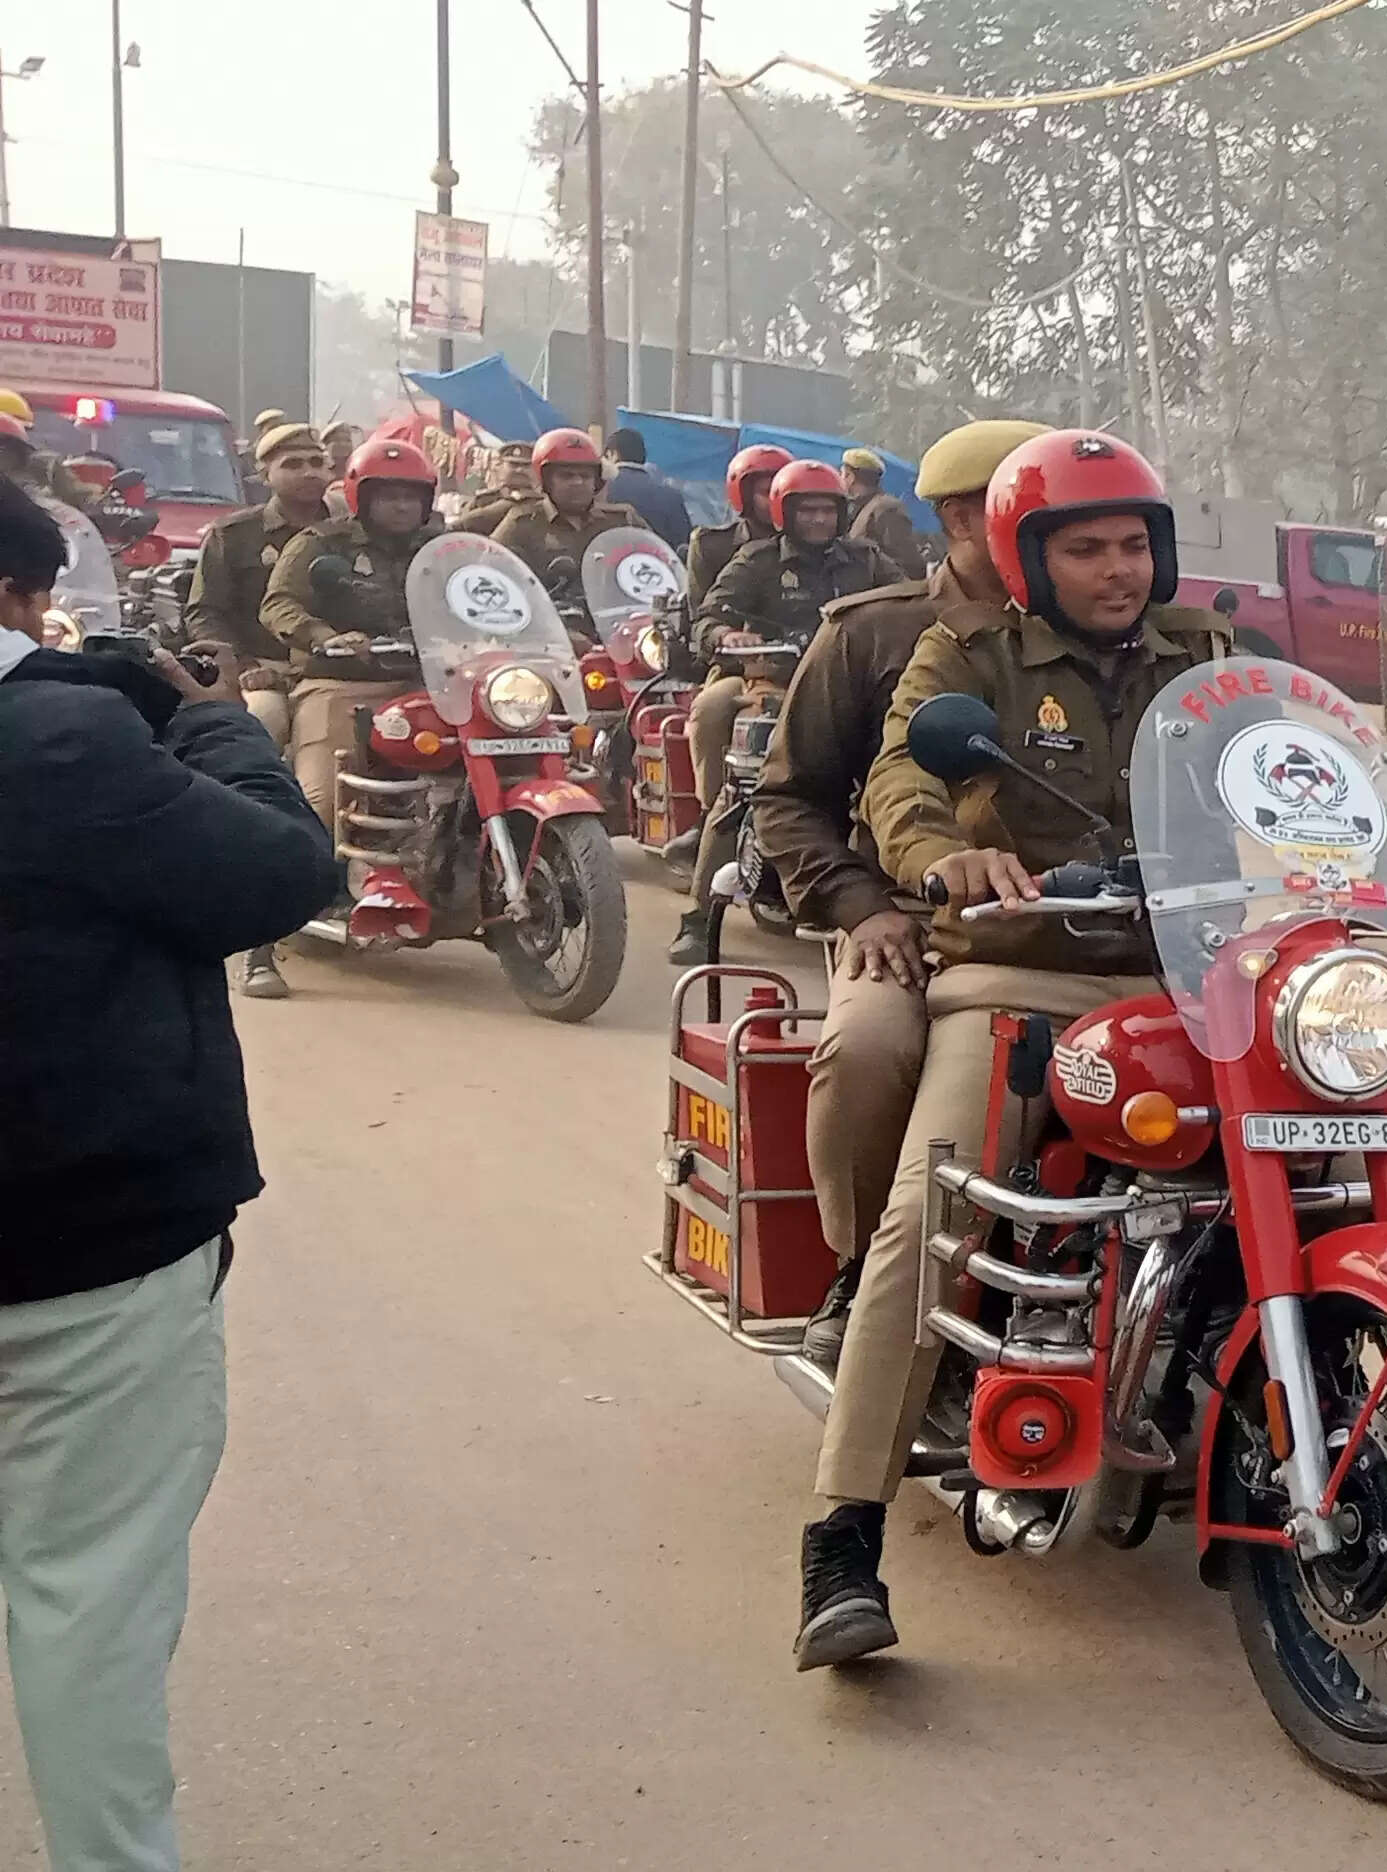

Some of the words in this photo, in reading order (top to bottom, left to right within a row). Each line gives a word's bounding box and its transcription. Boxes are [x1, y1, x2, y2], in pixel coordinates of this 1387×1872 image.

[1180, 665, 1273, 724] FIRE
[1290, 673, 1379, 747] BIKE
[689, 1094, 732, 1151] FIR
[687, 1216, 732, 1277] BIK
